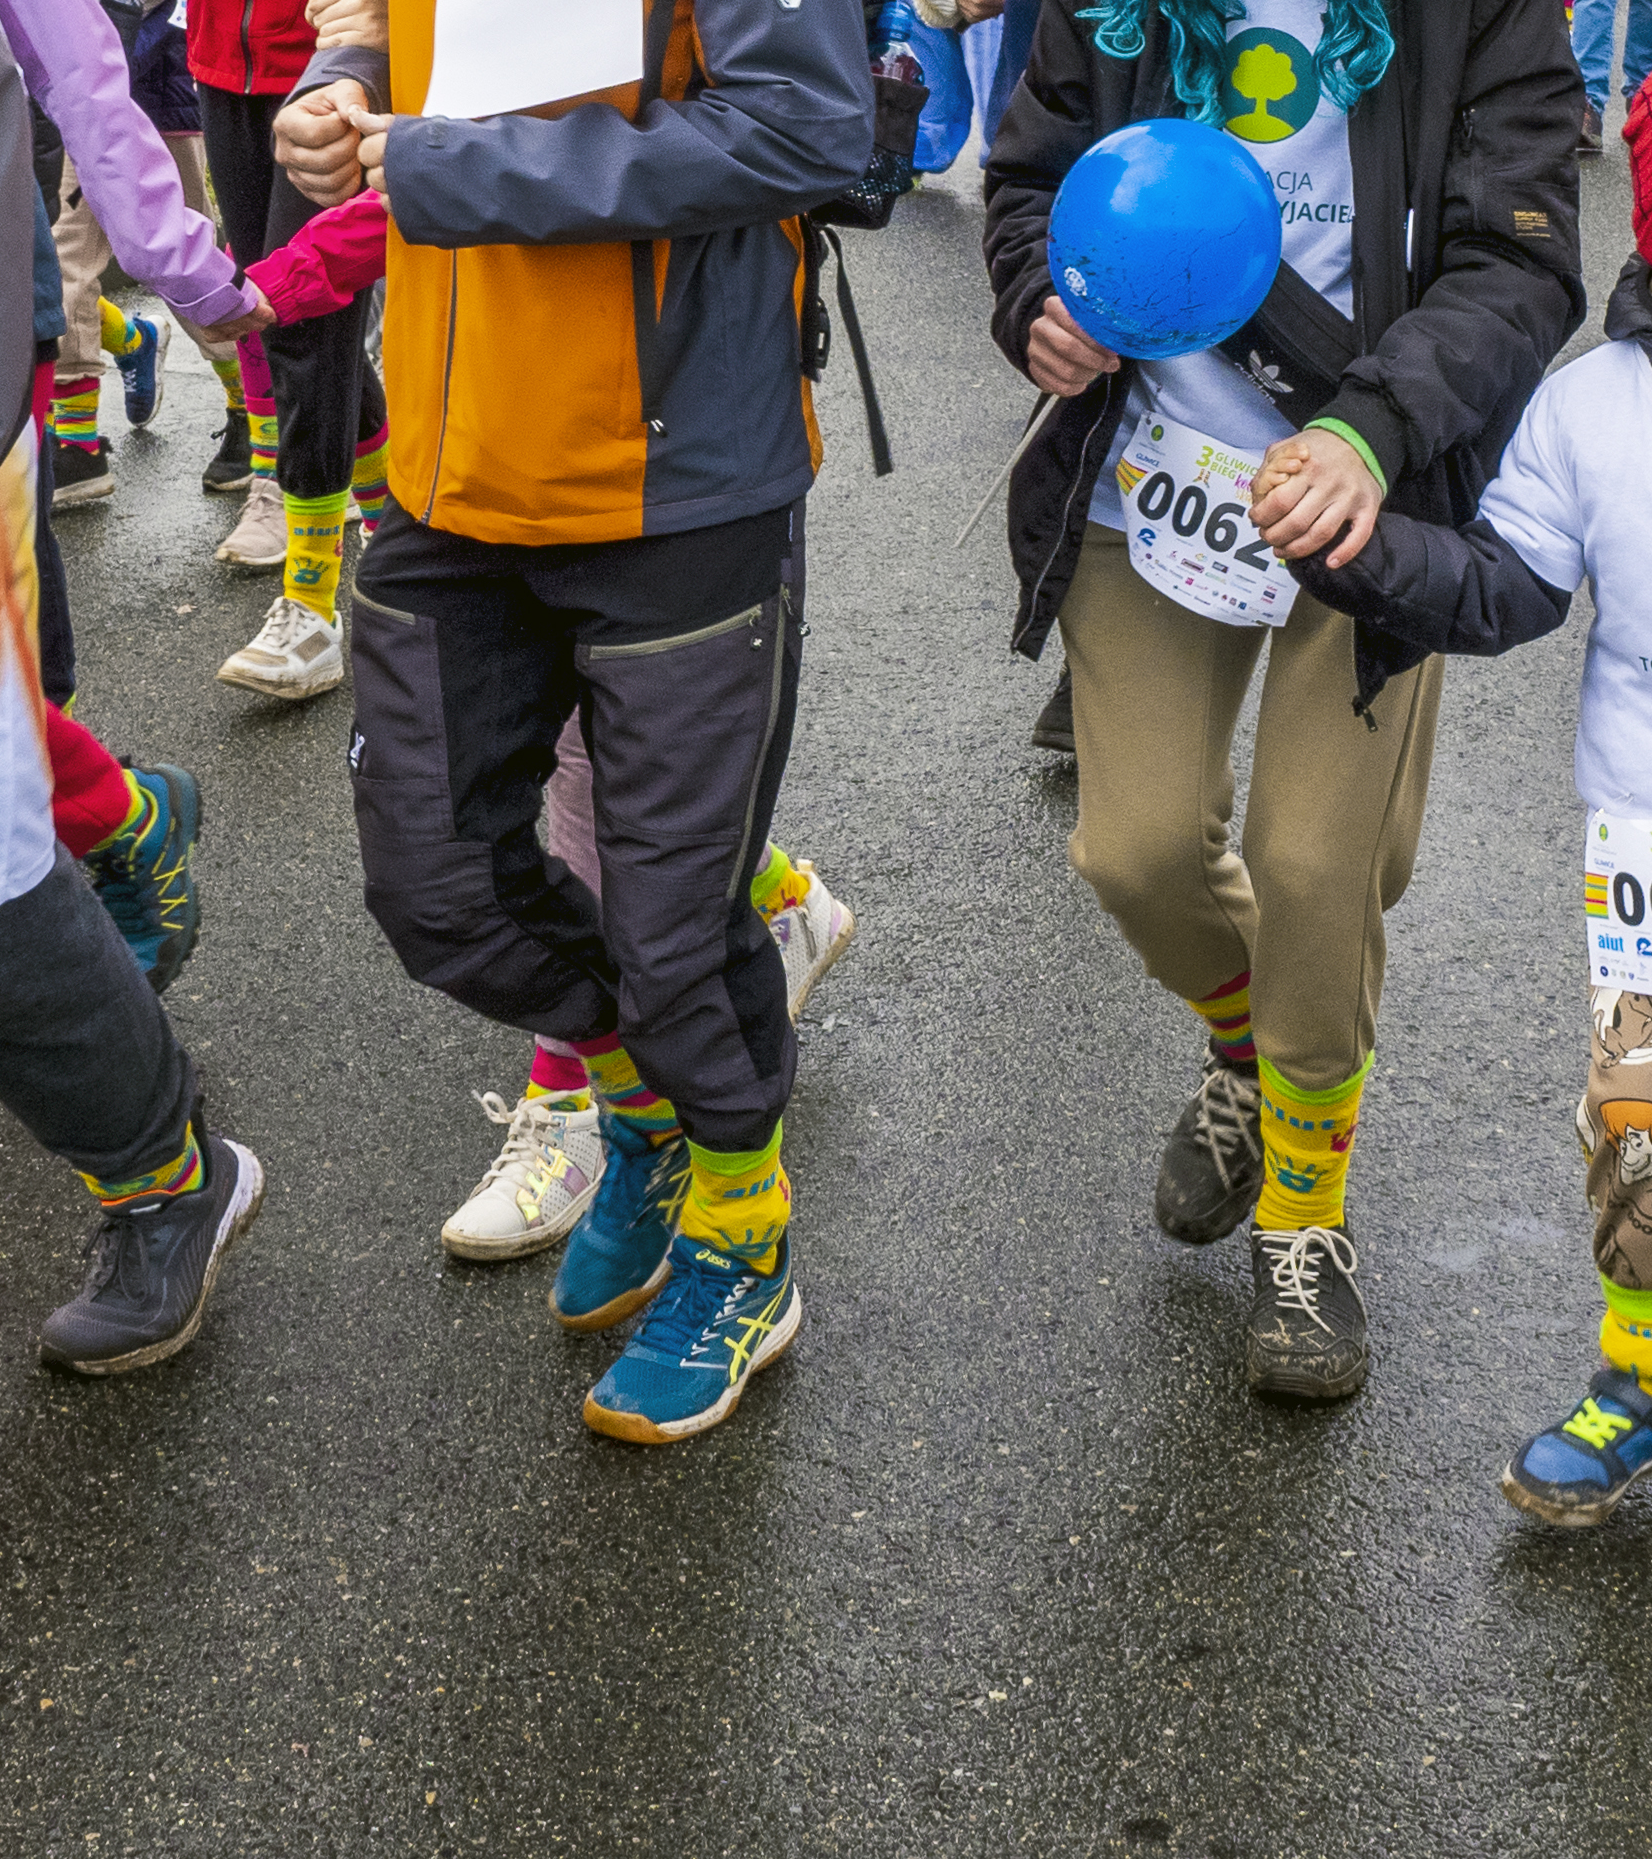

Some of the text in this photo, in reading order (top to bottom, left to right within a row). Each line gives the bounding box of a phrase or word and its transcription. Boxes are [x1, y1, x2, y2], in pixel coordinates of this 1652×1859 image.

[1195, 445, 1214, 467] 3
[1209, 462, 1237, 480] BIEG
[1597, 933, 1625, 953] aiut
